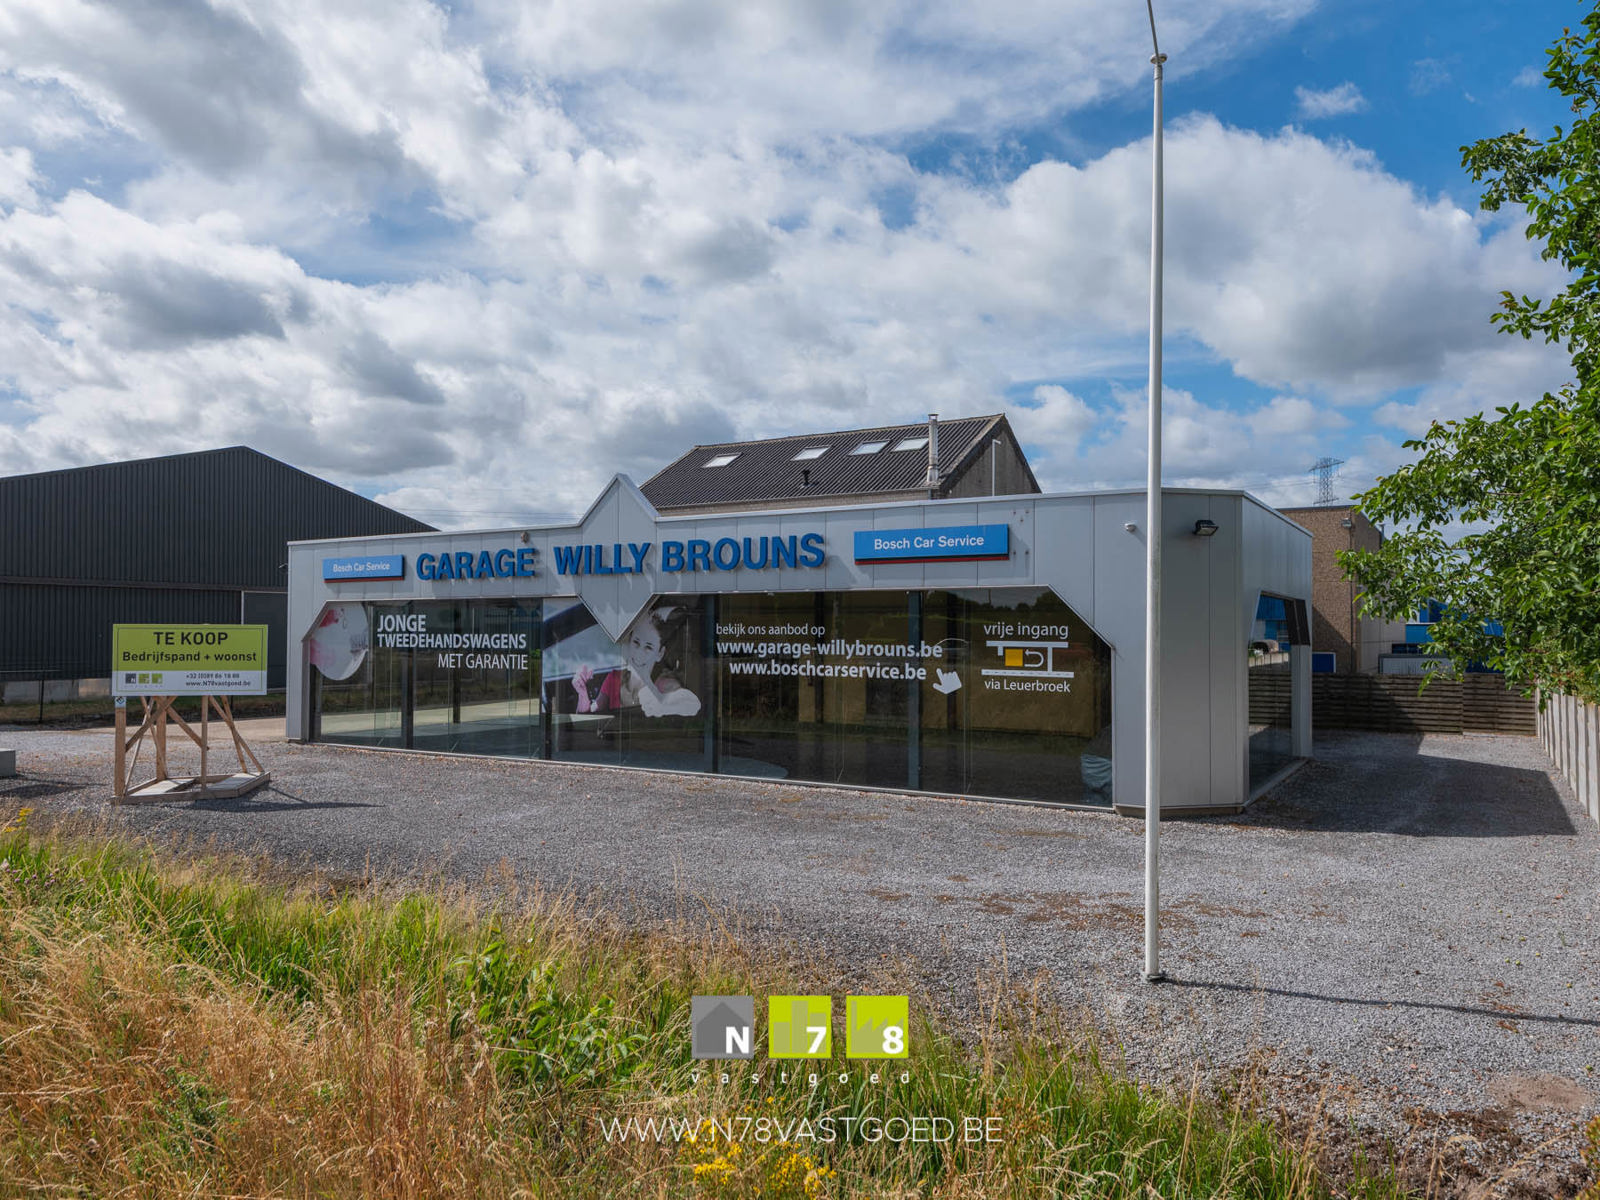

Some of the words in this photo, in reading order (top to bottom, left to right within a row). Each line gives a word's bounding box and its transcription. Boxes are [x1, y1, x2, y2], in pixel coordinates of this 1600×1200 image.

[874, 538, 910, 550] Bosch
[913, 536, 935, 548] Car
[938, 534, 985, 547] Service
[416, 548, 536, 581] GARAGE
[553, 542, 651, 576] WILLY
[661, 532, 825, 573] BROUNS
[333, 564, 353, 572] Bosch
[354, 563, 365, 571] Car
[366, 562, 391, 571] Service
[377, 614, 427, 632] JONGE
[716, 623, 746, 637] bekijk
[748, 626, 766, 635] ons
[768, 623, 808, 636] aanbod
[811, 626, 826, 637] op
[983, 622, 1014, 638] vrije
[1017, 622, 1069, 640] ingang
[153, 632, 175, 645] TE
[180, 632, 228, 645] KOOP
[377, 633, 527, 649] TWEEDEHANDSWAGENS
[716, 640, 943, 659] www.garage-willybrouns.be
[123, 652, 200, 664] Bedrijfspand
[214, 652, 257, 662] woonst
[438, 653, 463, 668] MET
[465, 654, 528, 670] GARANTIE
[729, 659, 927, 680] www.boschcarservice.be
[984, 679, 1001, 690] via
[1003, 679, 1071, 693] Leuerbroek
